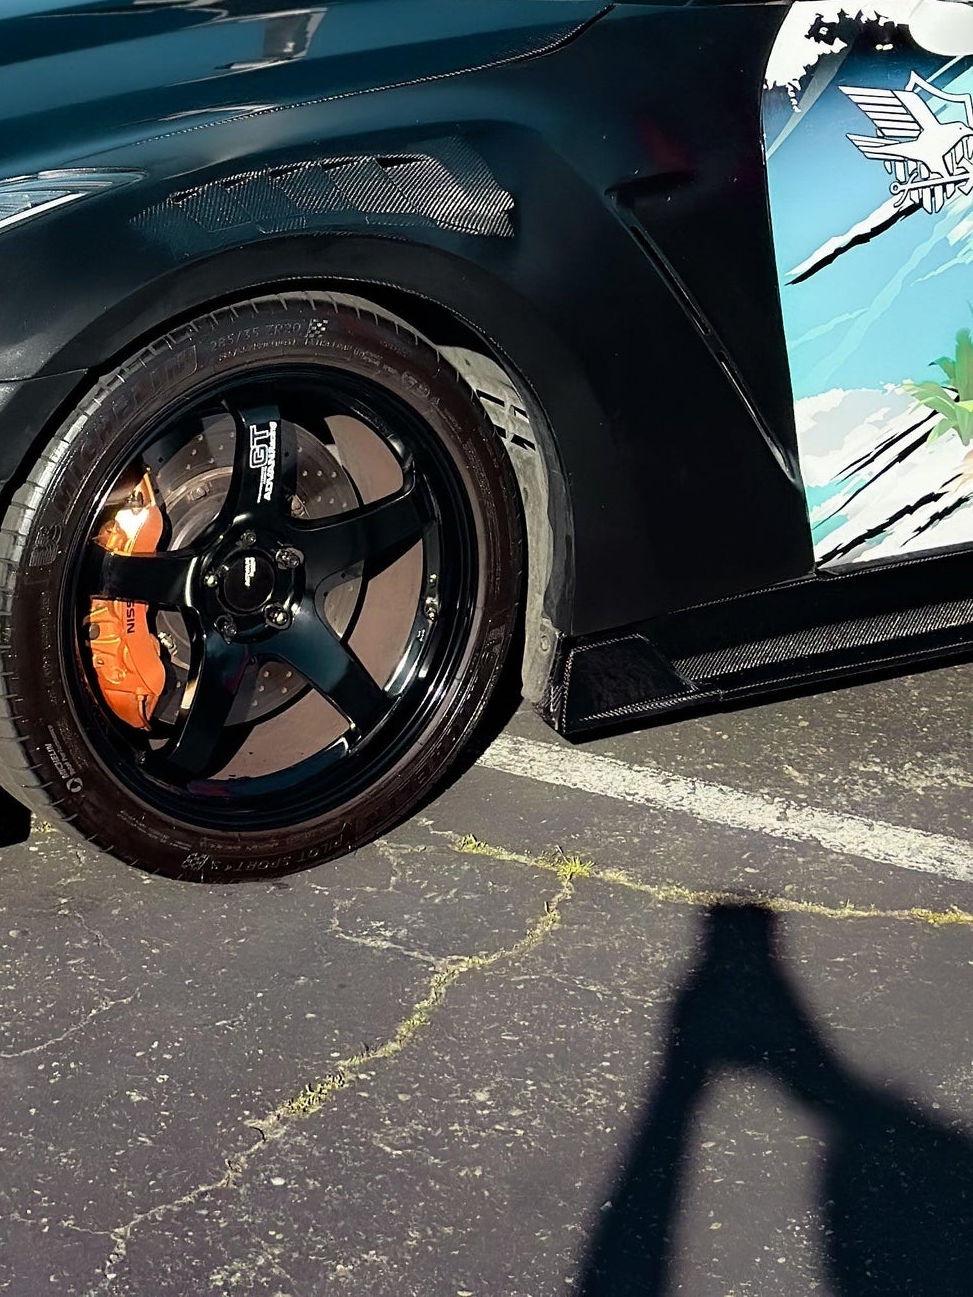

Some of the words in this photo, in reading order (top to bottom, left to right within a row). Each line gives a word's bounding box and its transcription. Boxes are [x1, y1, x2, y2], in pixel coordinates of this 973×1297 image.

[249, 425, 269, 469] GT
[126, 598, 135, 634] NISS
[232, 856, 292, 872] SPORT
